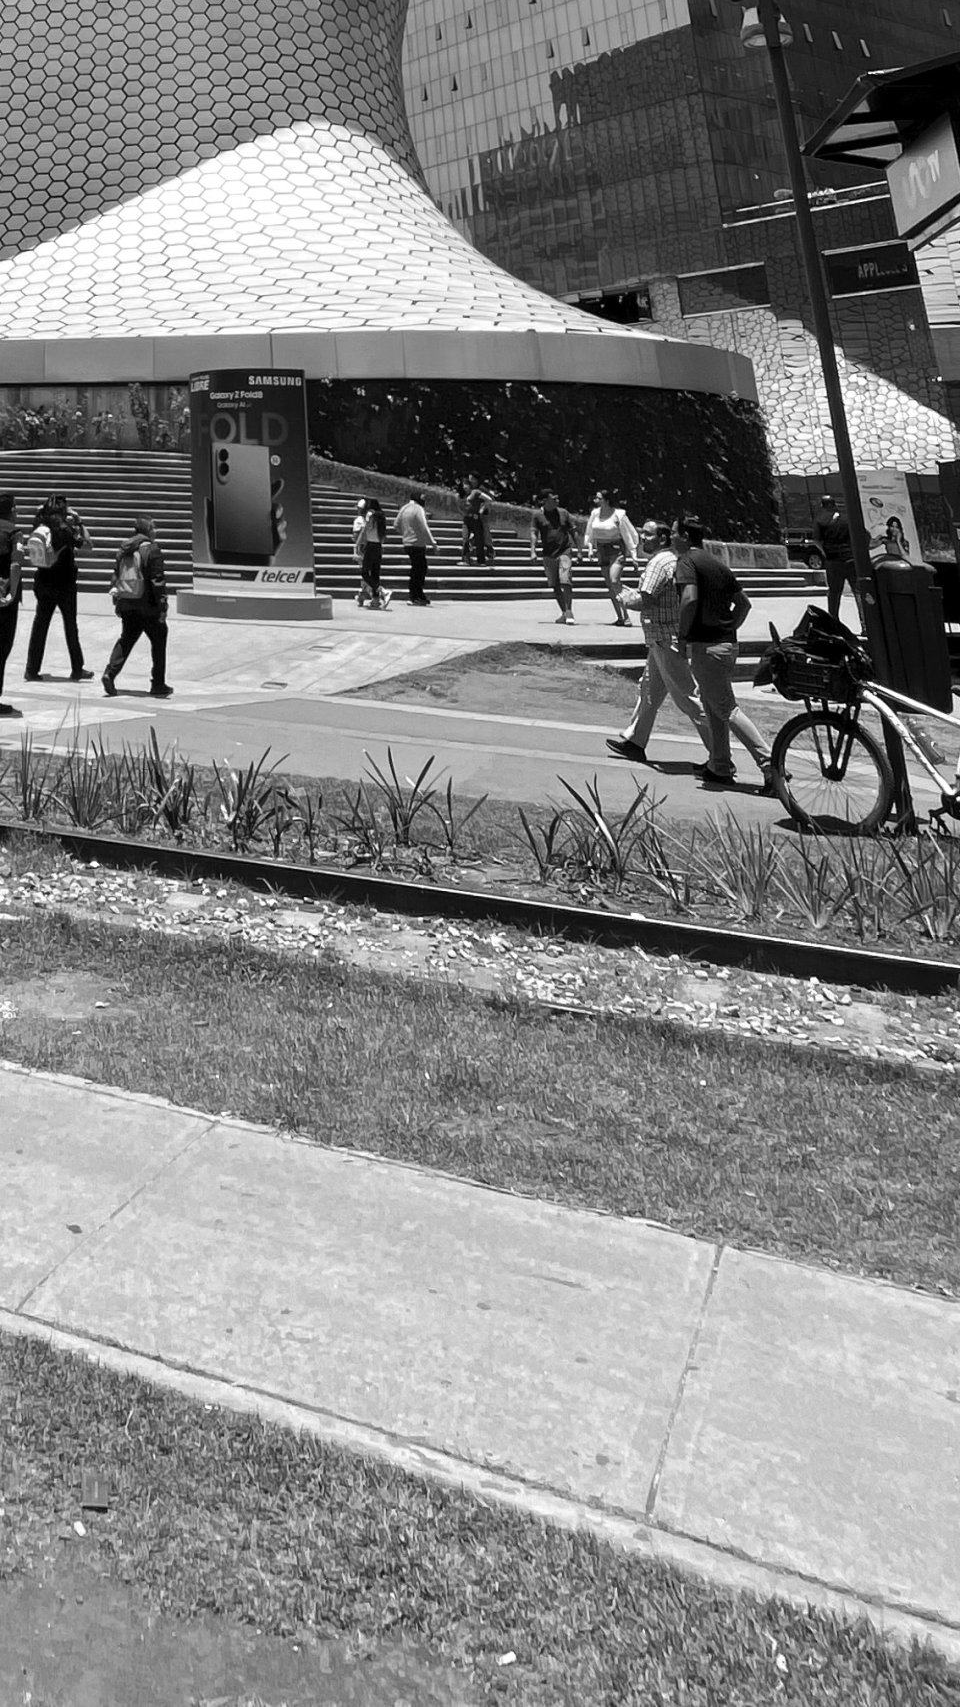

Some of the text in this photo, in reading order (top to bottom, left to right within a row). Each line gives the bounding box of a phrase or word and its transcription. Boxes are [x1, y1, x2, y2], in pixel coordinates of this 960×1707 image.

[248, 375, 302, 387] SAMSUNG
[210, 392, 234, 400] Galaxy
[261, 569, 301, 583] telcel
